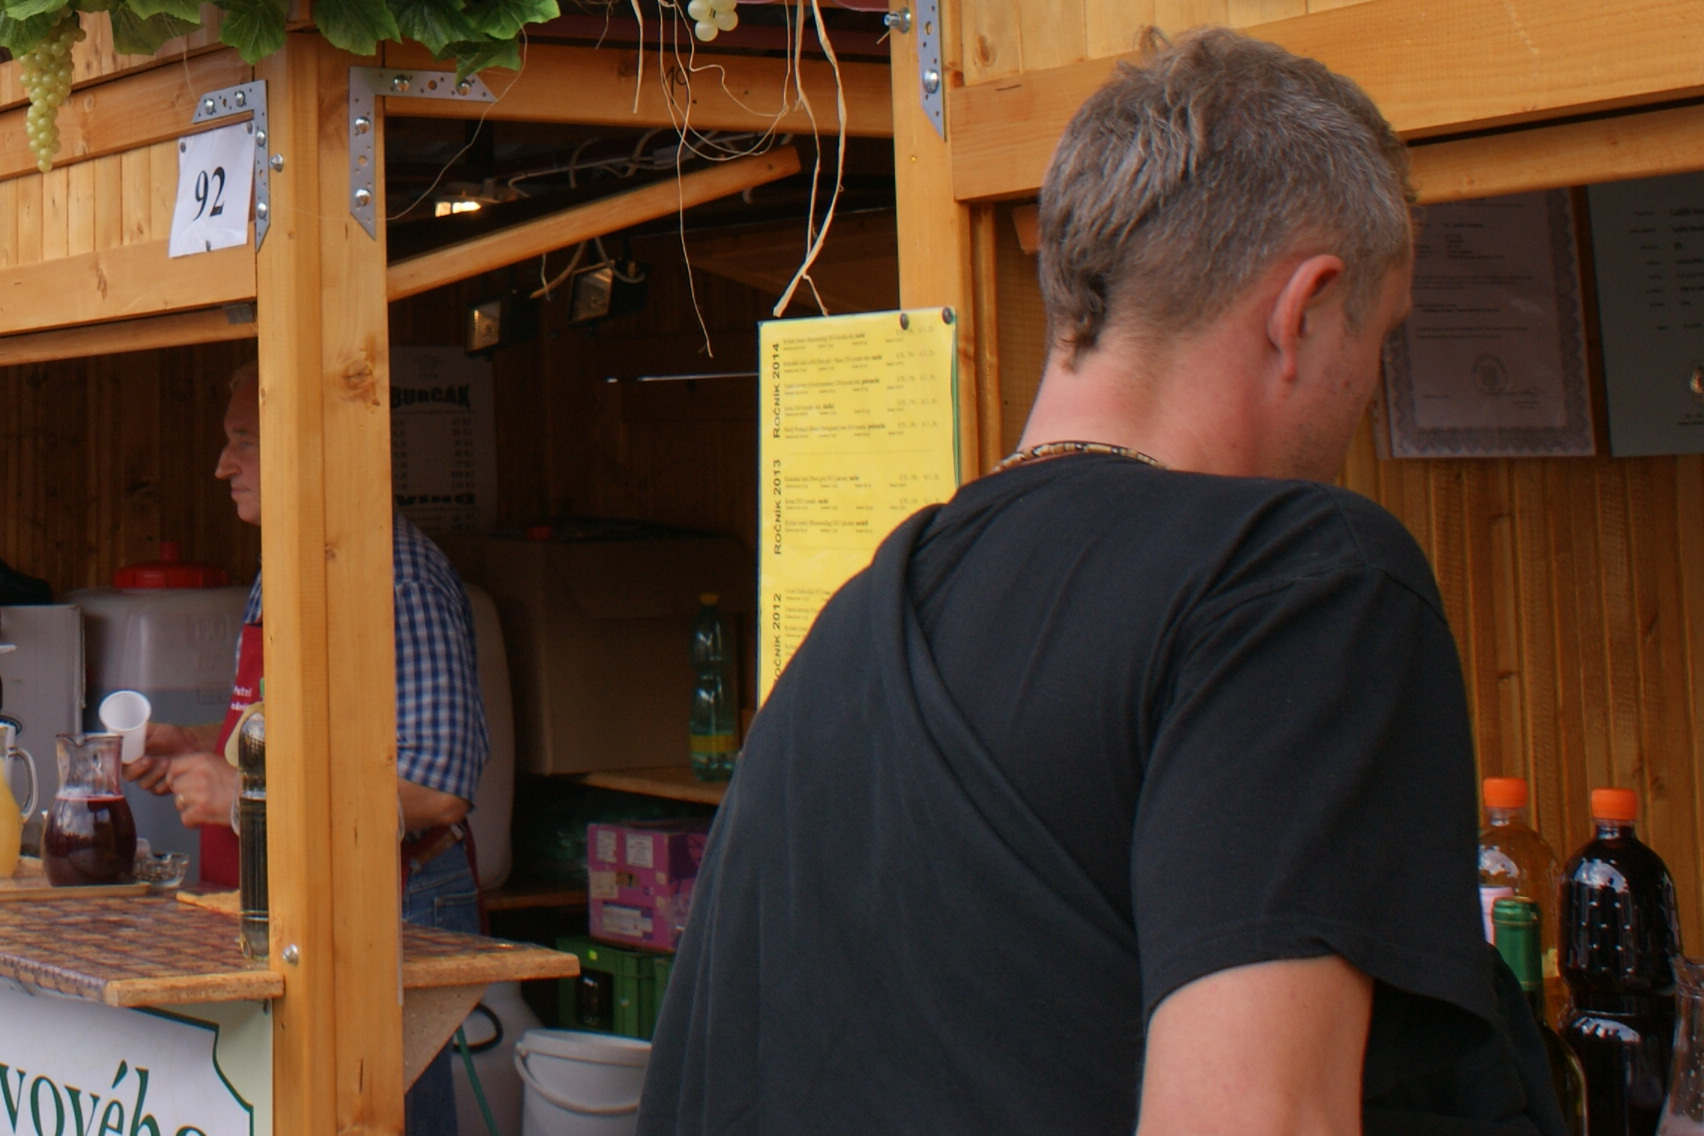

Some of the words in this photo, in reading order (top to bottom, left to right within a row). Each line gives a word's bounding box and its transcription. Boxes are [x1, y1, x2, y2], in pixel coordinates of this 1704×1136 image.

[192, 165, 226, 222] 92
[772, 343, 781, 380] 2014
[772, 459, 782, 496] 2013
[772, 592, 782, 631] 2012
